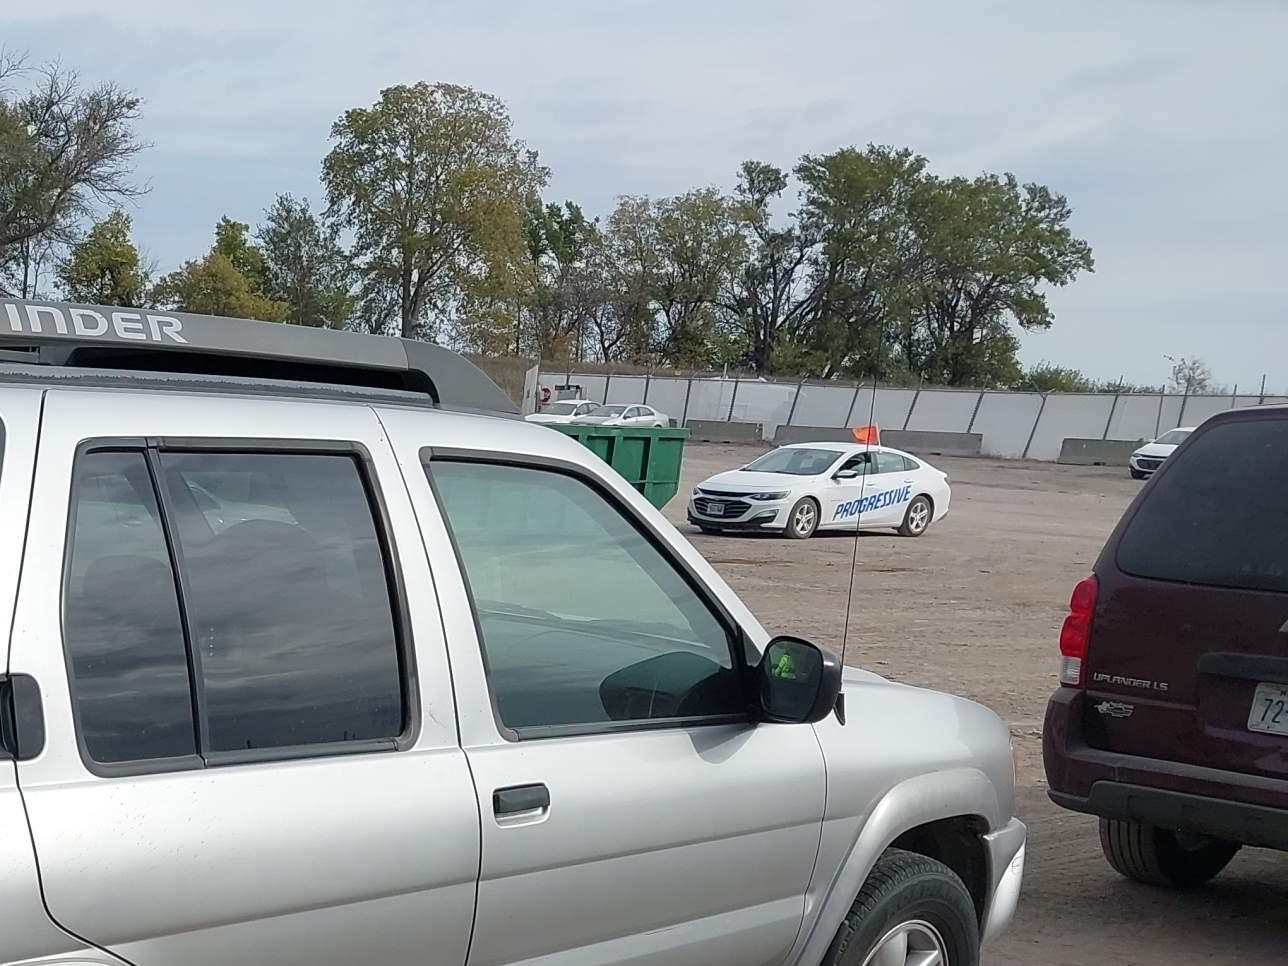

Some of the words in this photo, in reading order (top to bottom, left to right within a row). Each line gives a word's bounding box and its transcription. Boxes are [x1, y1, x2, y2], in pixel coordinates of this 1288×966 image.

[832, 484, 912, 521] PROGRESSIVE
[1093, 671, 1152, 689] UPLANDER
[1153, 681, 1169, 691] LS
